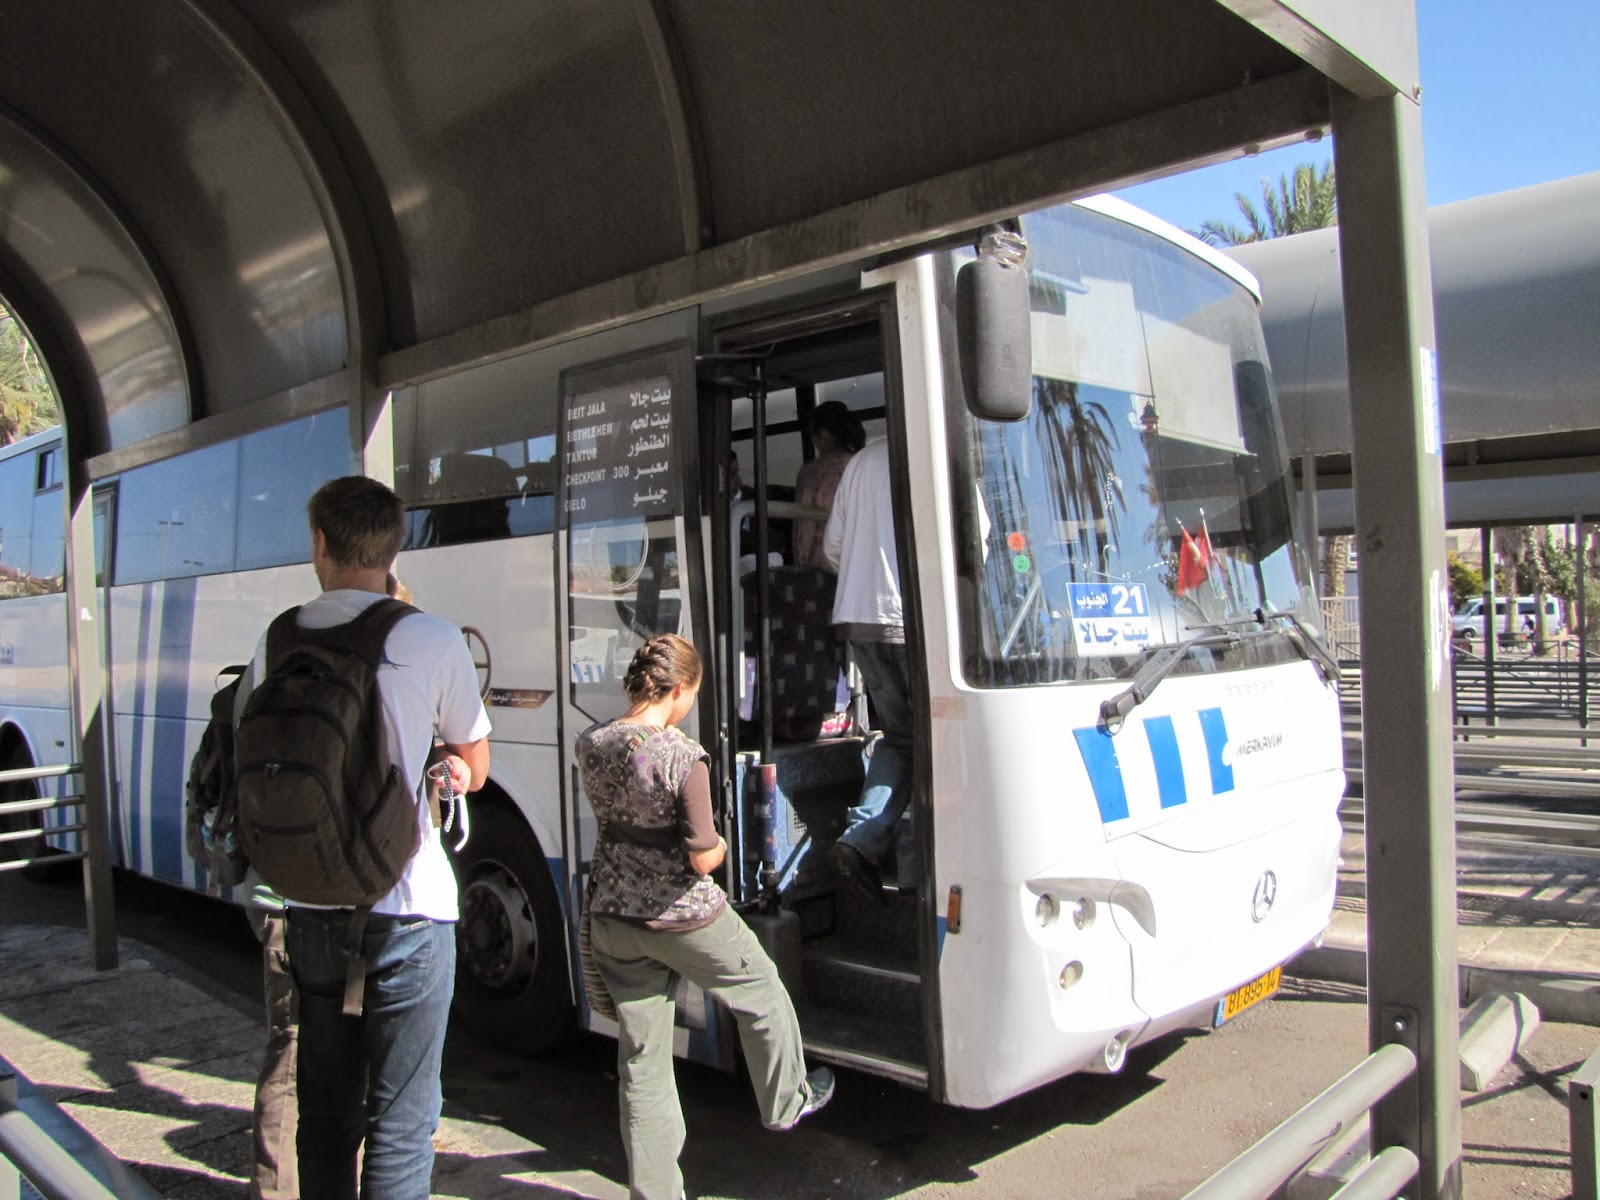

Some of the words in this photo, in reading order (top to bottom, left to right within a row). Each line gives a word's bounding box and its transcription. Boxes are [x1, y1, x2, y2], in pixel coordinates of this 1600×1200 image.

[630, 392, 650, 408] جالا
[651, 388, 672, 405] بيت
[567, 406, 585, 421] BEIT
[586, 401, 606, 416] JALA
[650, 412, 671, 428] بيت
[566, 422, 613, 443] BETHLEHEM
[630, 413, 649, 434] لحم
[627, 433, 670, 457] الطنطور
[566, 447, 597, 464] TANTUR
[565, 469, 606, 486] CHECKPOINT
[612, 465, 630, 479] 300
[633, 460, 669, 480] معبر
[564, 497, 587, 512] GELO
[632, 486, 668, 507] جيلو
[1075, 591, 1109, 610] الجنوب
[1111, 585, 1144, 615] 21
[1079, 621, 1118, 647] جالا
[1122, 622, 1150, 648] بيت
